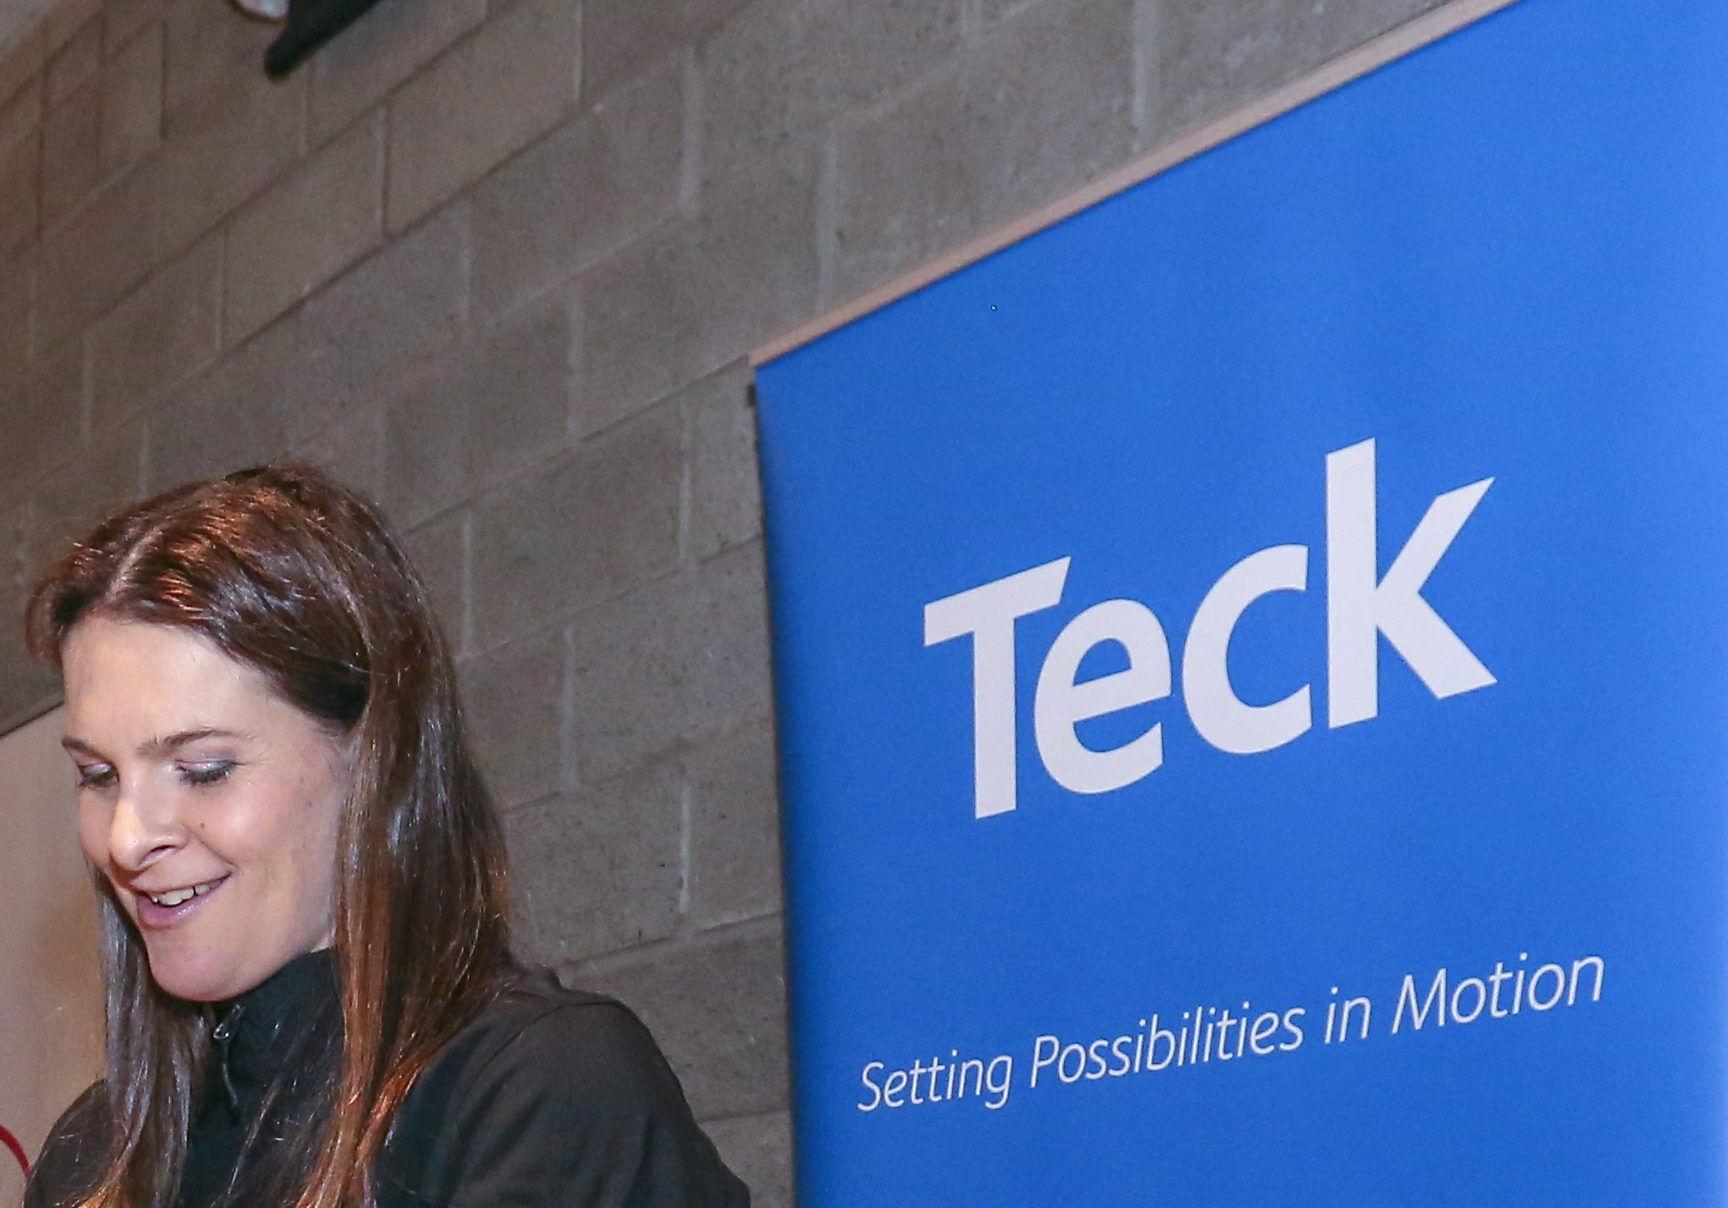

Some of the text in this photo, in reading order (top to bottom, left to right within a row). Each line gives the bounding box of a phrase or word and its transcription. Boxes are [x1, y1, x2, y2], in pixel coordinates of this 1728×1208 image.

[924, 437, 1498, 819] Teck
[857, 952, 1605, 1112] Setting Possibilities in Motion
